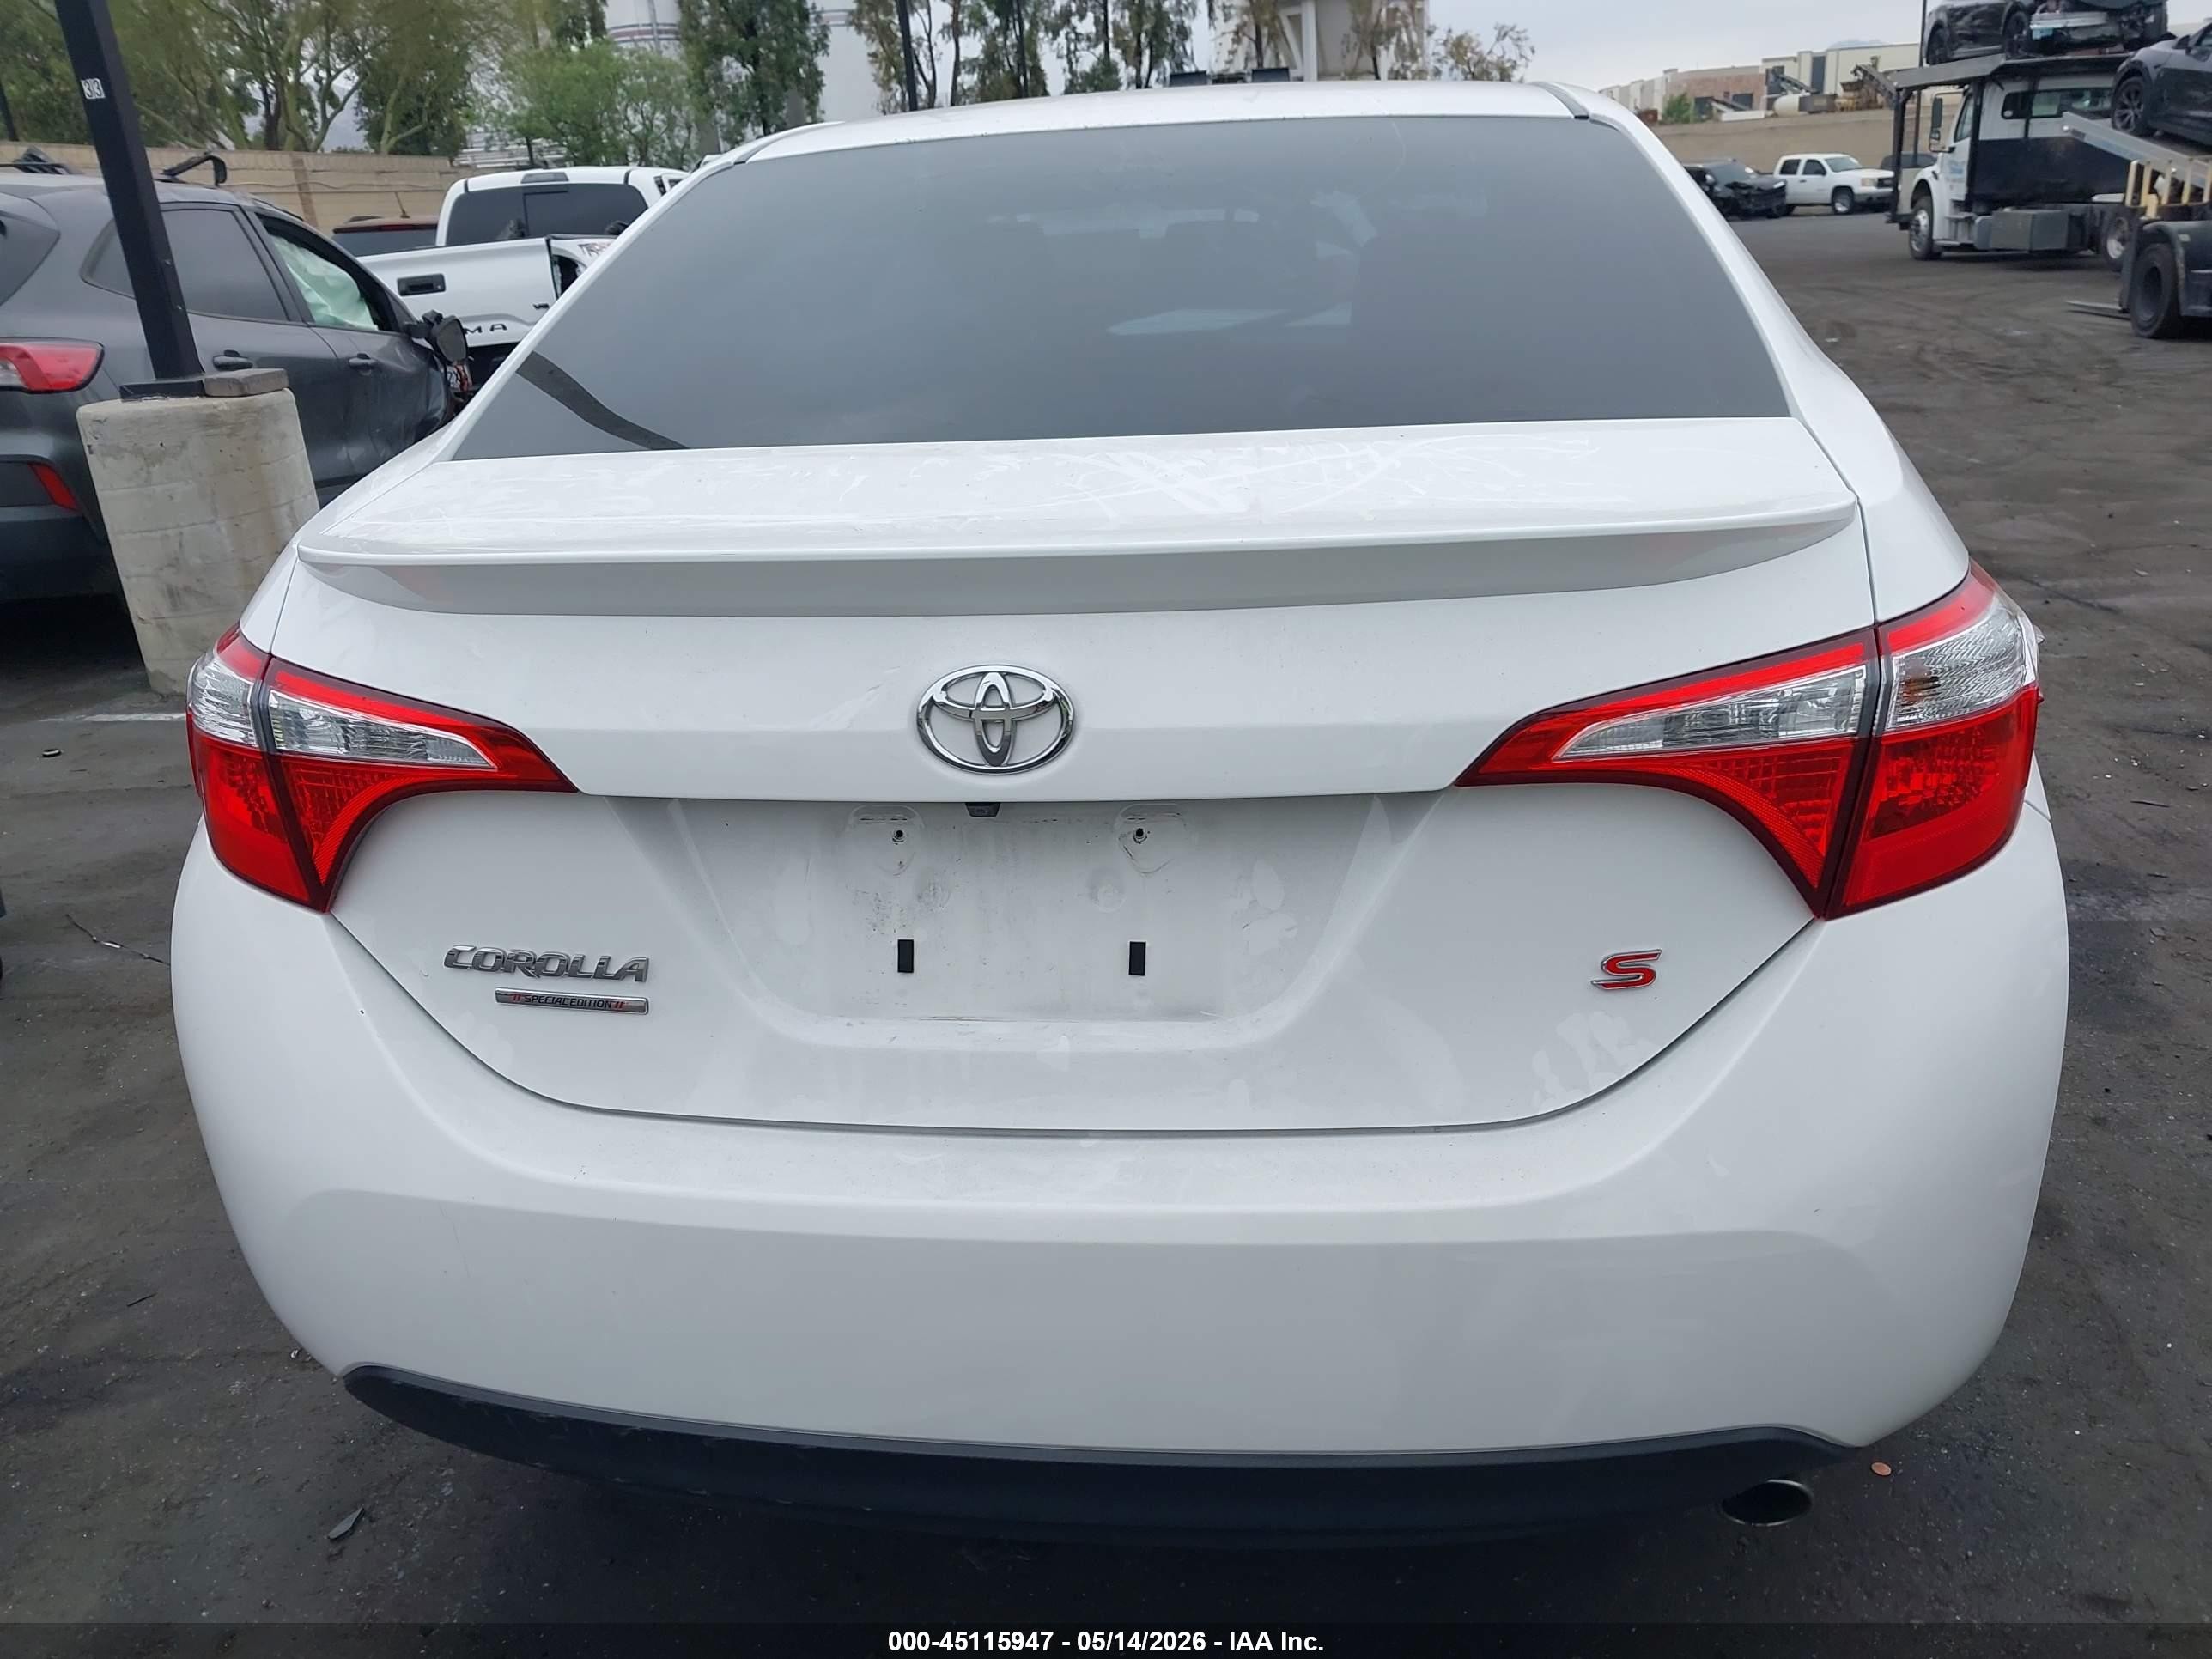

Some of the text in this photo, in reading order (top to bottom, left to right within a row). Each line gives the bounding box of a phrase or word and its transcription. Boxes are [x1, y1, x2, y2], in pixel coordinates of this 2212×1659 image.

[83, 79, 102, 98] 33
[444, 944, 650, 982] COROLLA
[1590, 948, 1662, 991] S
[524, 994, 612, 1009] SPECIAL EDITION
